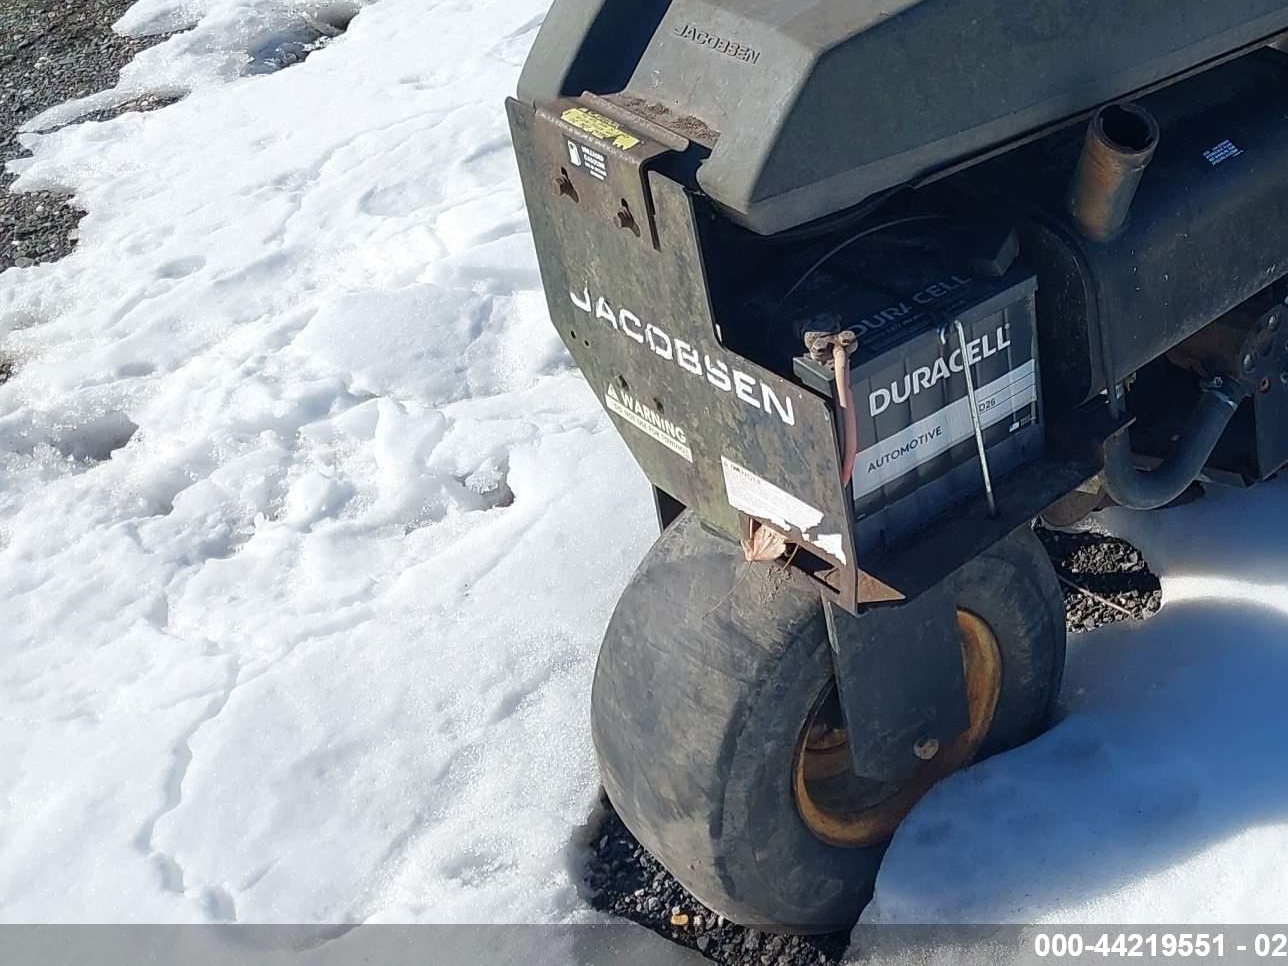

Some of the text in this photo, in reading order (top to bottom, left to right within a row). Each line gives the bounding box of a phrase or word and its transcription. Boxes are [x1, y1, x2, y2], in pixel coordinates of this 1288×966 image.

[674, 24, 760, 65] JACOBSEN
[570, 284, 795, 427] JACOBSEN
[869, 324, 1011, 418] DURACELL
[620, 389, 687, 444] WARNING
[867, 425, 942, 474] AUTOMOTIVE
